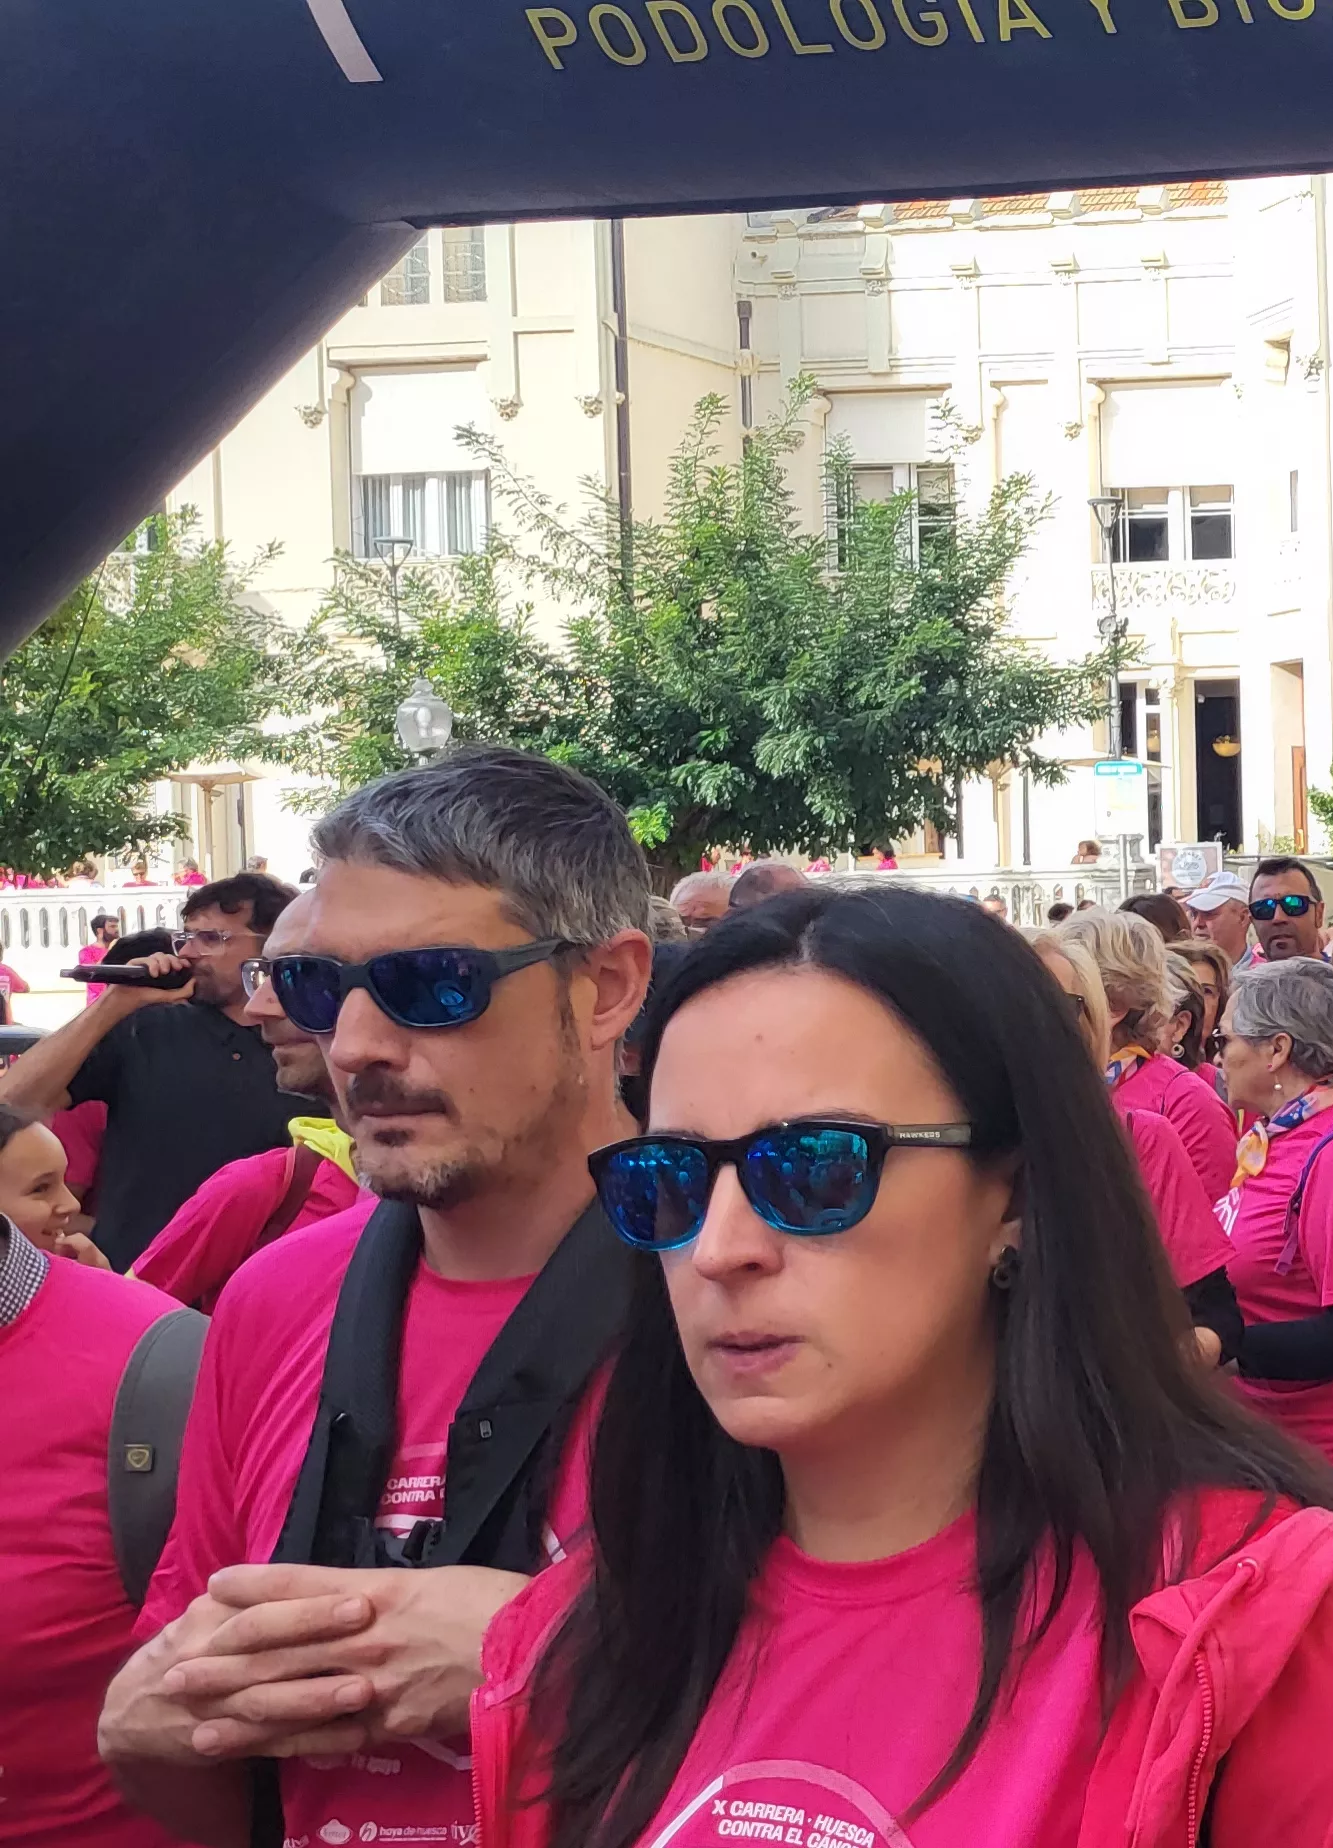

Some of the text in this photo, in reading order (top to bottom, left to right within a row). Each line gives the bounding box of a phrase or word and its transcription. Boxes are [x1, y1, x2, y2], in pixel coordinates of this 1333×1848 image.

[381, 1489, 436, 1505] CONTRA
[712, 1800, 876, 1847] X CARRERA HUESCA
[718, 1819, 784, 1842] CONTRA
[785, 1828, 804, 1846] EL
